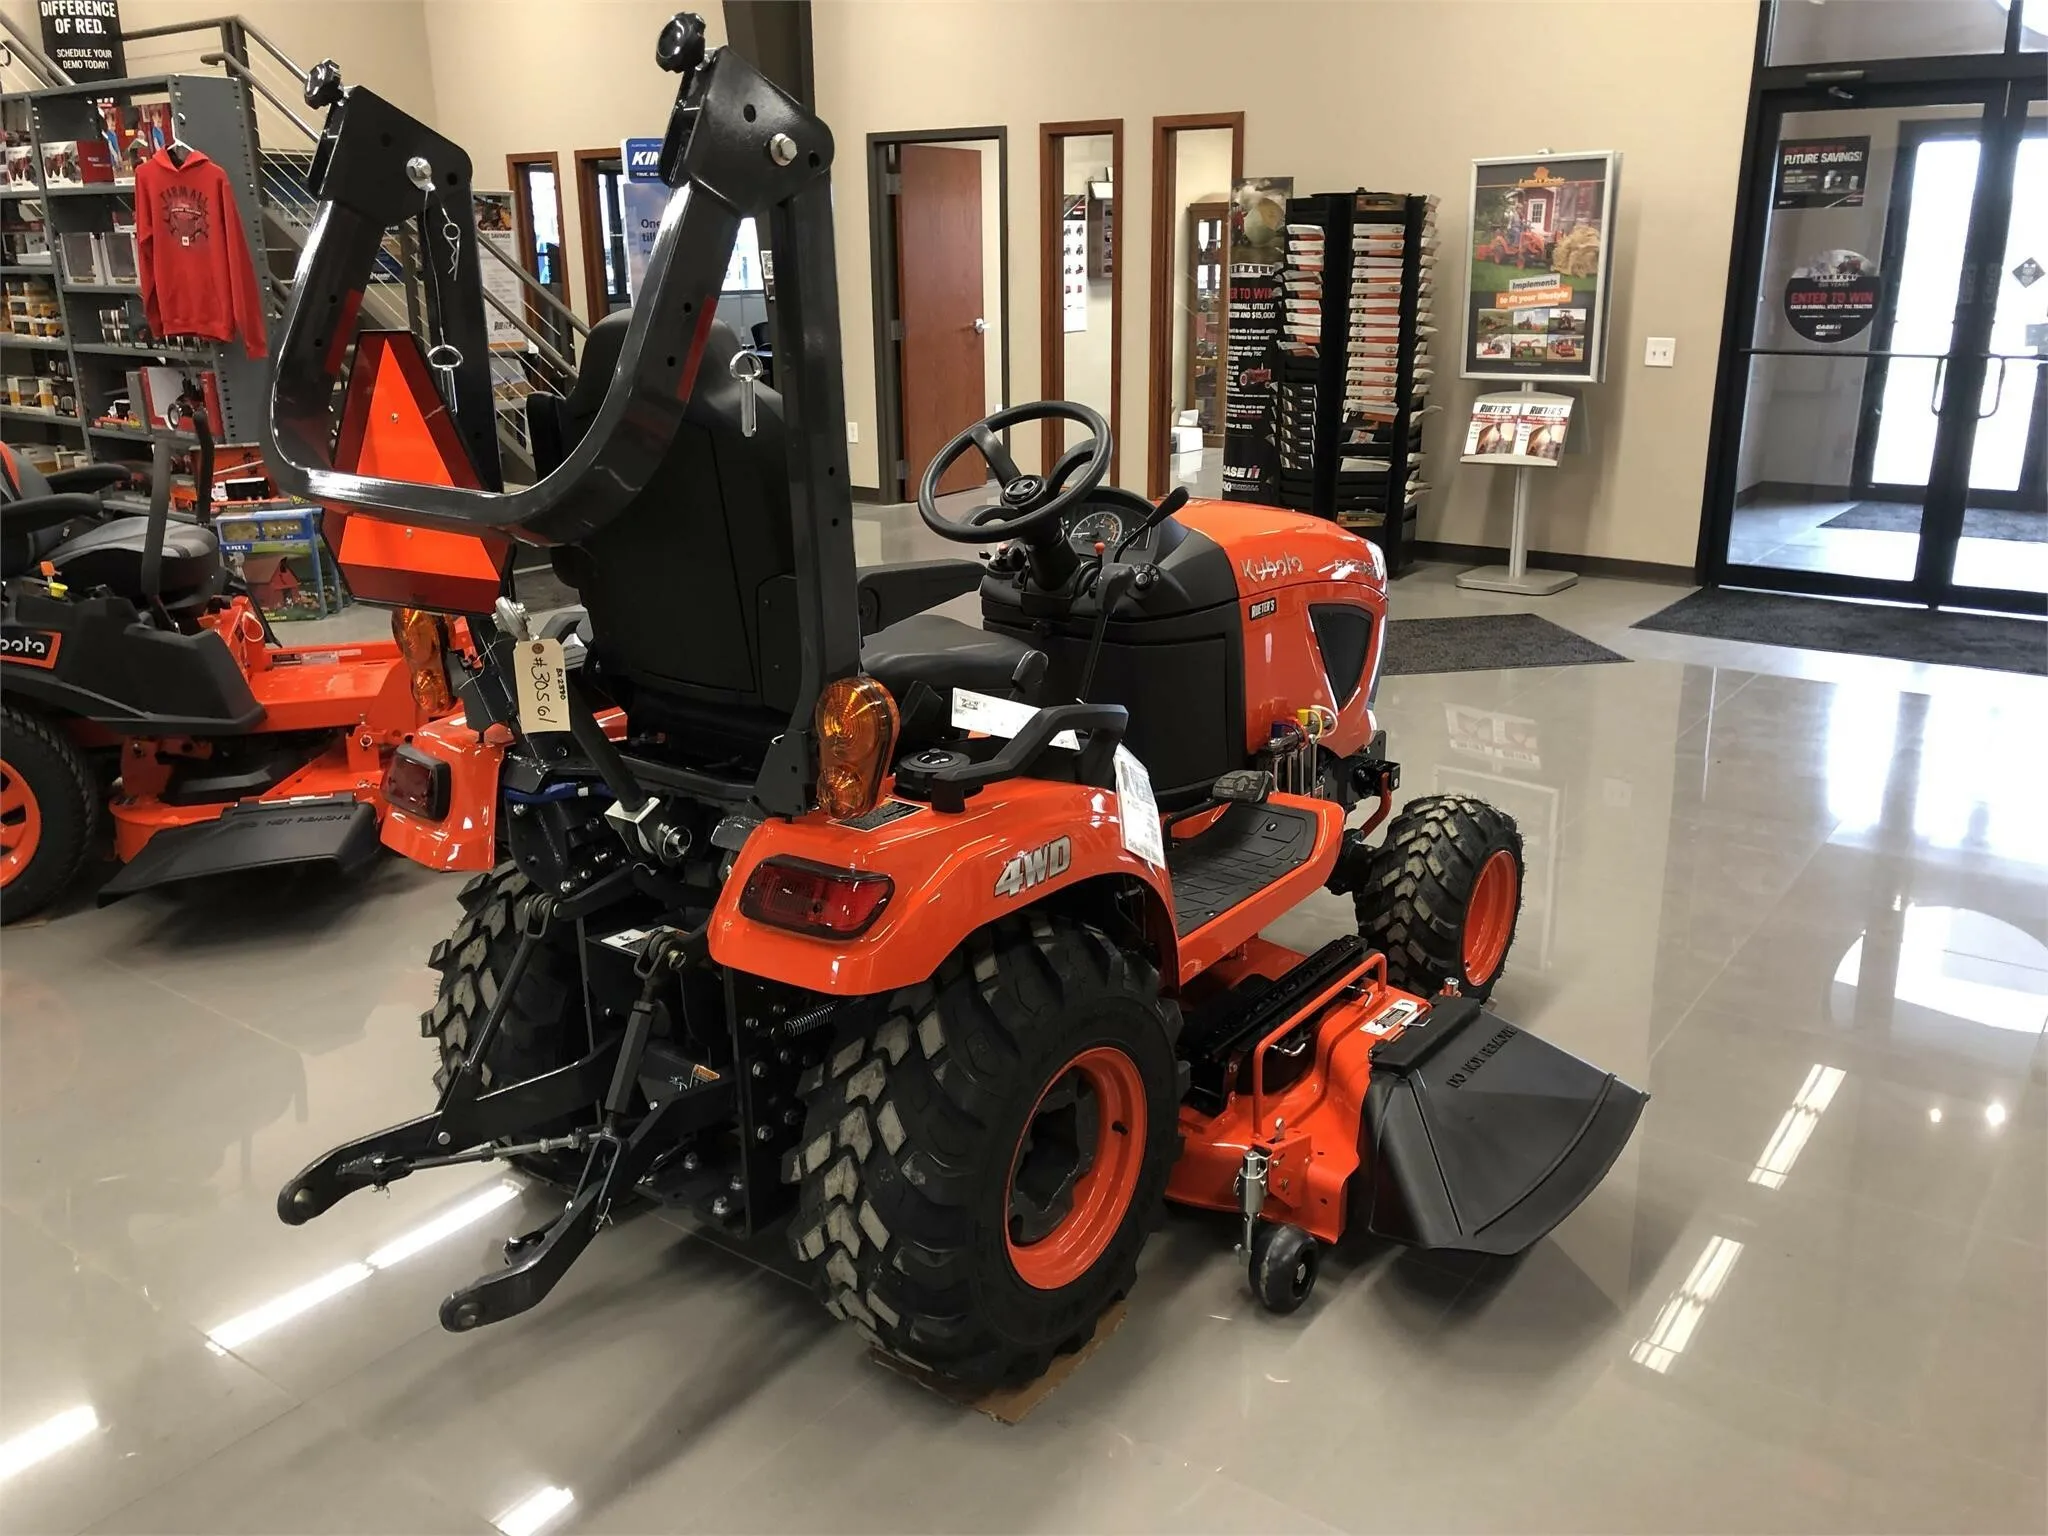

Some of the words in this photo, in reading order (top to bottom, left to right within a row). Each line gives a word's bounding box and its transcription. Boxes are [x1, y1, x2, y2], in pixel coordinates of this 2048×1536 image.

[41, 1, 116, 17] DIFFERENCE
[55, 18, 71, 34] OF
[75, 18, 107, 35] RED.
[57, 49, 92, 58] SCHEDULE
[93, 49, 112, 58] YOUR
[63, 60, 83, 69] DEMO
[84, 60, 109, 70] TODAY!
[1784, 153, 1818, 165] FUTURE
[1820, 151, 1862, 163] SAVINGS!
[1512, 279, 1558, 290] Implements
[1240, 287, 1250, 299] TO
[1499, 296, 1508, 304] to
[1509, 294, 1518, 303] fit
[1519, 295, 1536, 304] your
[1537, 290, 1569, 301] lifestyle
[1791, 292, 1827, 304] ENTER
[1832, 292, 1846, 303] TO
[1850, 291, 1873, 303] WIN
[1252, 311, 1276, 319] $15,000
[1240, 551, 1303, 583] Kubota
[1251, 599, 1275, 619] RUETER'S
[994, 834, 1071, 898] 4WD
